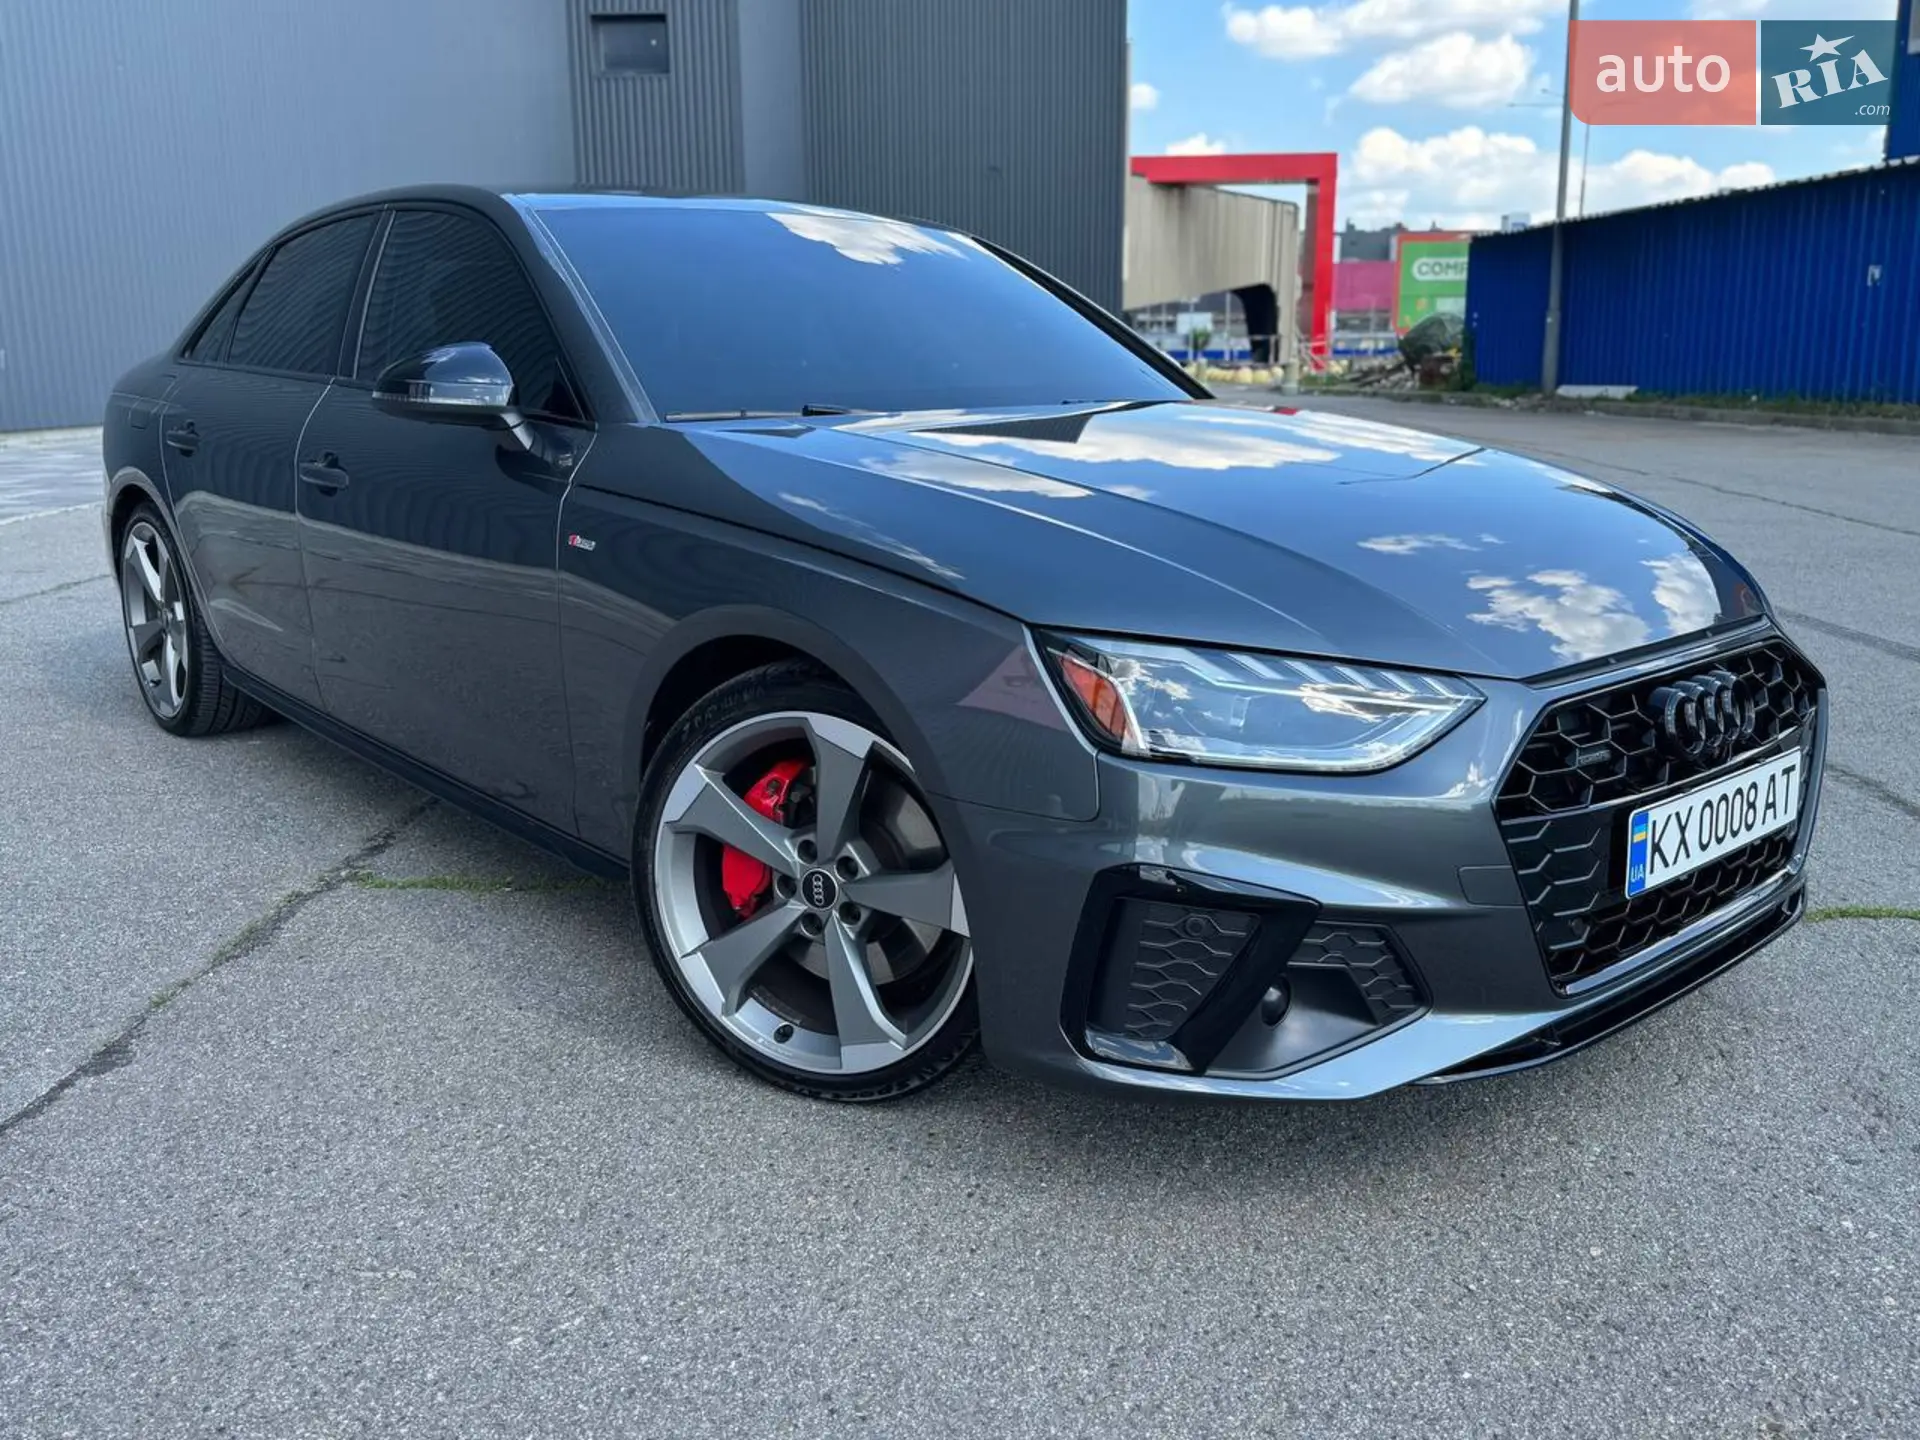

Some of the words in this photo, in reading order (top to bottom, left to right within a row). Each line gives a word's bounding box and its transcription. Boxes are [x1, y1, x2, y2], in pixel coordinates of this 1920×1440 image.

[1649, 805, 1694, 875] KX
[1698, 781, 1759, 852] 0008
[1762, 764, 1797, 826] AT
[1630, 863, 1645, 883] UA
